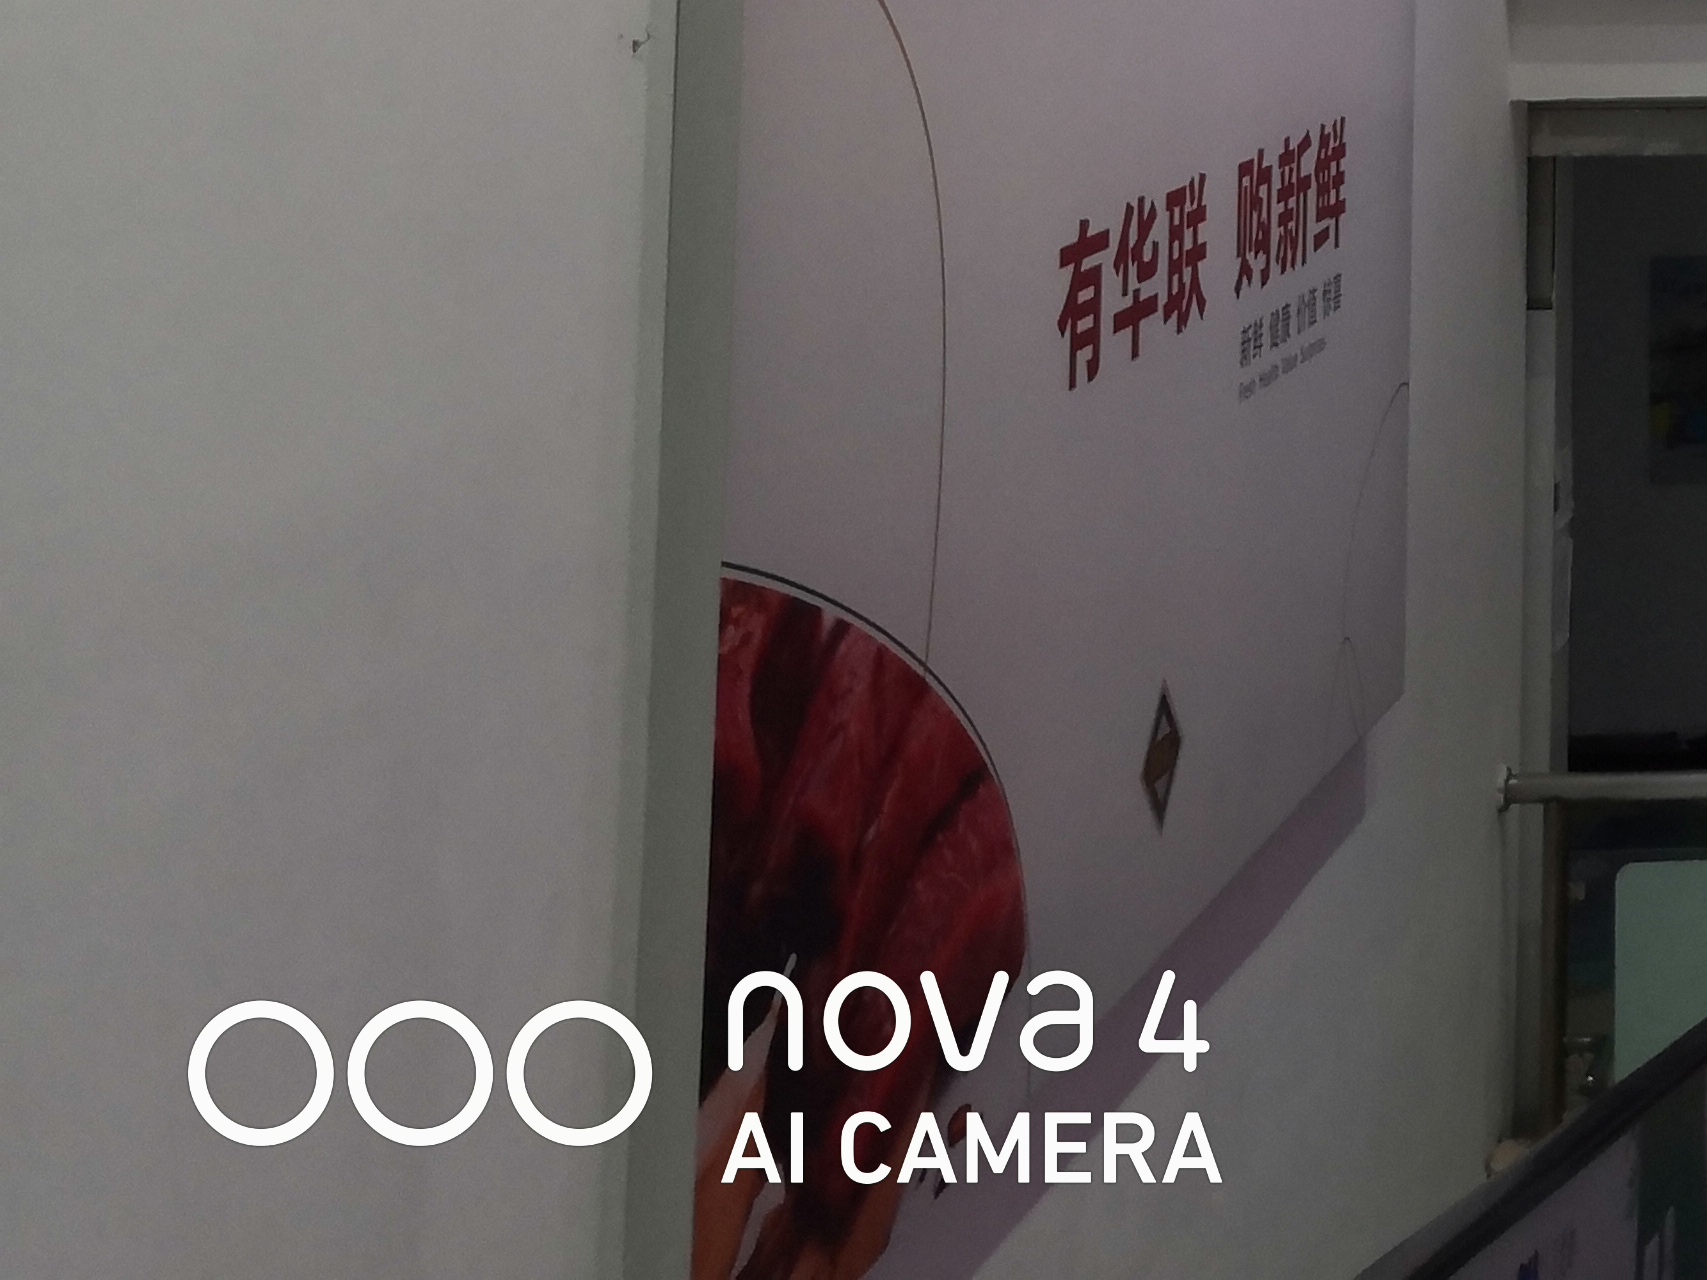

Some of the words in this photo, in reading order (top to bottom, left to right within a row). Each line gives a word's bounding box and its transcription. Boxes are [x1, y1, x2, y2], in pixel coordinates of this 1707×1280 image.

[1057, 171, 1208, 393] 有华联
[1233, 115, 1347, 300] 购新鲜
[1239, 314, 1265, 369] 新鲜
